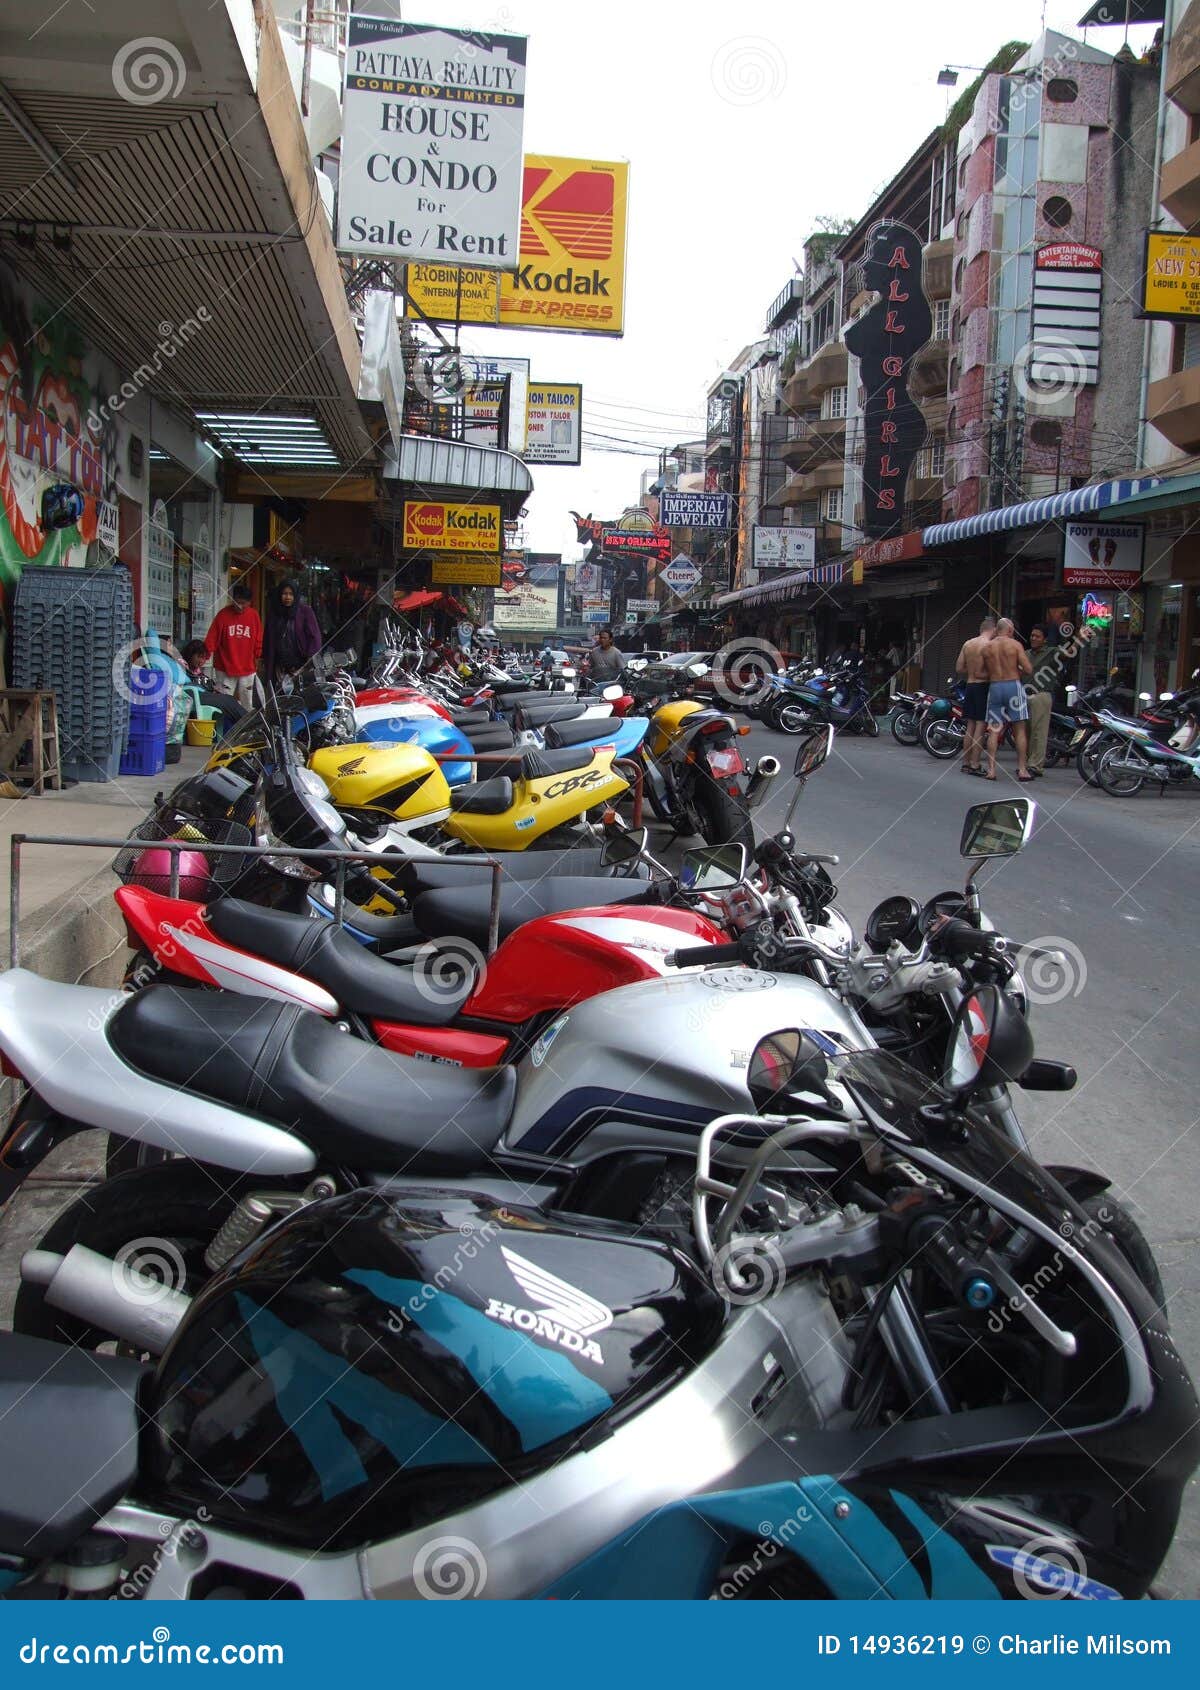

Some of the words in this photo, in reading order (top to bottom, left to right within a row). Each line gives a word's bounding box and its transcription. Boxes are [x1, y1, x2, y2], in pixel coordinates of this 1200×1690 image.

[355, 49, 434, 81] PATTAYA
[443, 61, 518, 90] REALTY
[356, 78, 440, 97] COMPANY
[446, 89, 516, 105] LIMITED
[380, 102, 490, 142] HOUSE
[427, 142, 440, 156] &
[366, 153, 498, 193] CONDO
[417, 198, 447, 214] For
[348, 216, 412, 247] Sale
[437, 224, 508, 257] Rent
[1039, 245, 1099, 259] ENTERTAINMENT
[1153, 258, 1185, 276] NEW
[513, 264, 611, 297] Kodak
[1153, 280, 1178, 288] LADIES
[421, 286, 490, 300] INTERNATIONAL
[547, 393, 575, 406] TAILOR
[473, 409, 493, 417] LADIES
[550, 411, 571, 420] TAILOR
[664, 499, 725, 513] IMPERIAL
[414, 513, 442, 528] Kodak
[447, 510, 497, 530] Kodak
[665, 513, 724, 527] JEWELRY
[1070, 526, 1094, 537] FOOT
[1097, 527, 1139, 539] MASSAGE
[406, 537, 446, 548] Digital
[450, 538, 496, 549] Service
[605, 535, 626, 545] NEW
[666, 570, 695, 582] Cheers
[1067, 576, 1092, 585] OVER
[1094, 577, 1111, 585] SEA
[1113, 578, 1136, 586] CALL
[228, 625, 251, 638] USA
[337, 770, 367, 778] HONDA
[543, 769, 603, 800] CBR
[485, 1298, 604, 1365] HONDA
